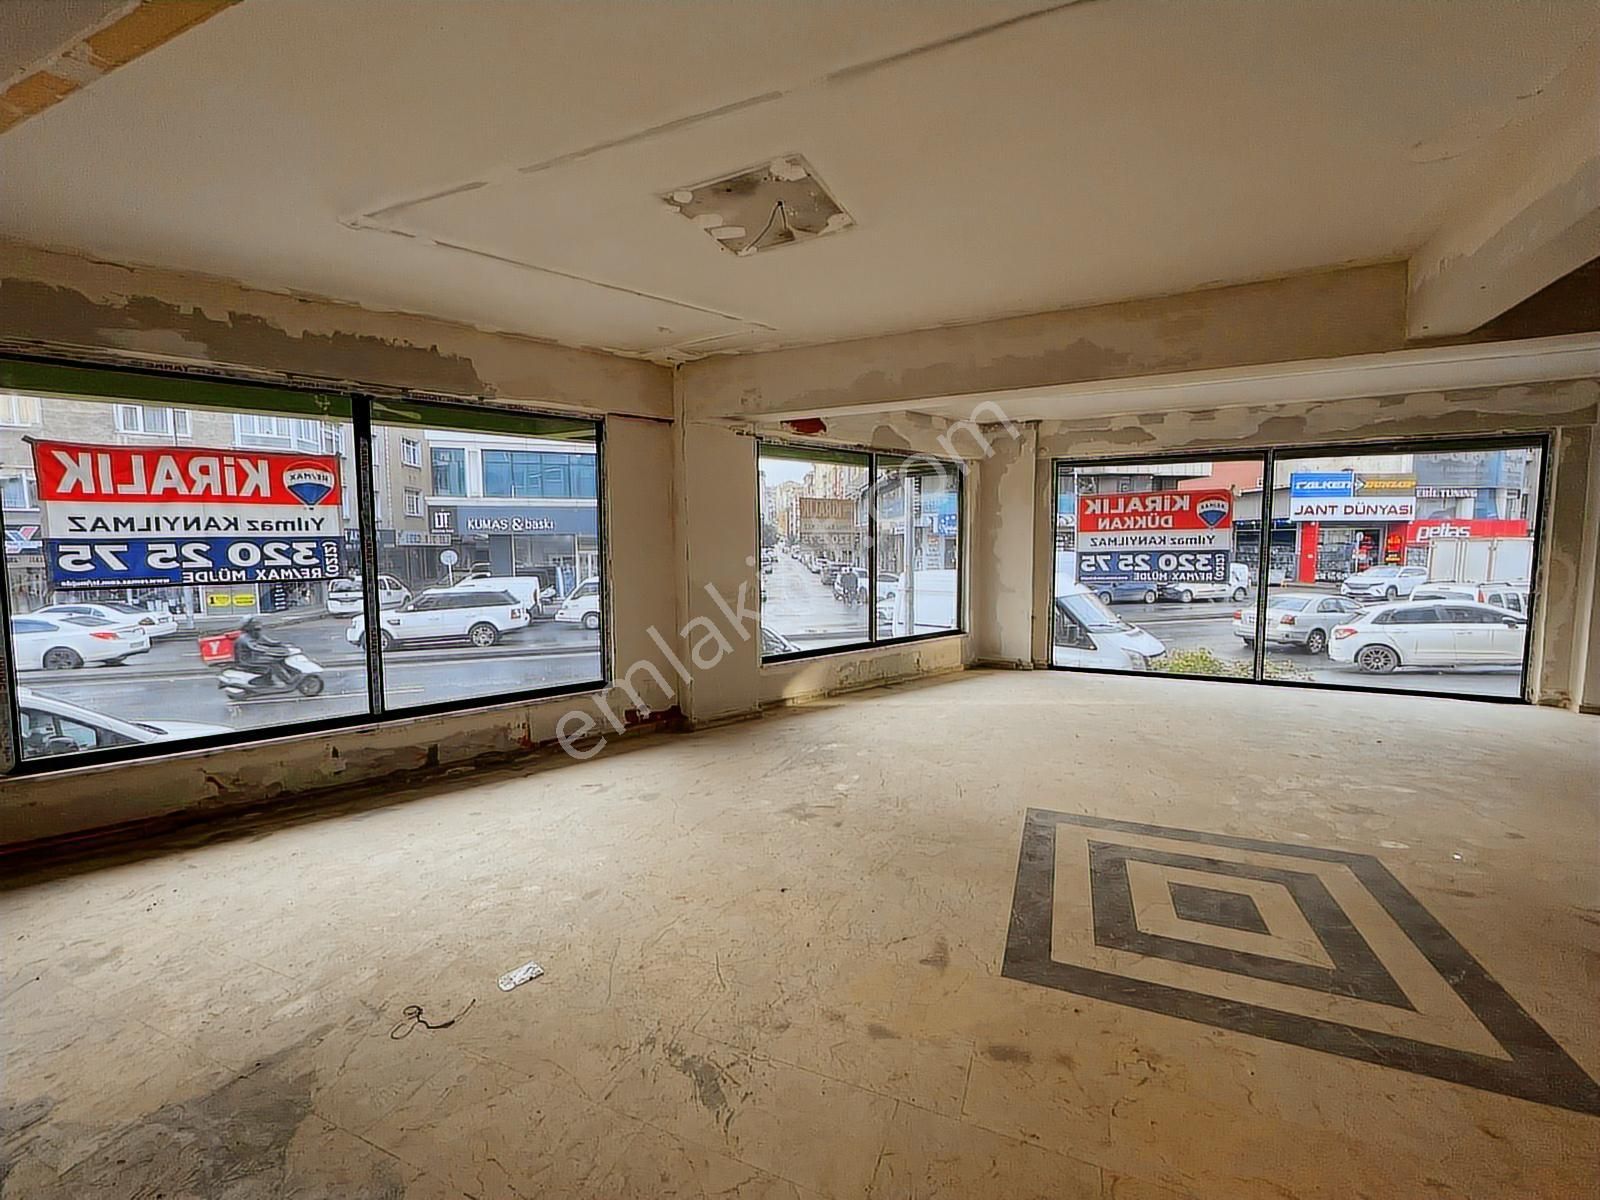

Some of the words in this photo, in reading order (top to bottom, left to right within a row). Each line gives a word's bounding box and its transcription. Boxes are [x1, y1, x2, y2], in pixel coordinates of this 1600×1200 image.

[1294, 504, 1339, 515] JANT
[1343, 501, 1413, 515] DÜNYASI
[1415, 522, 1472, 543] petlas
